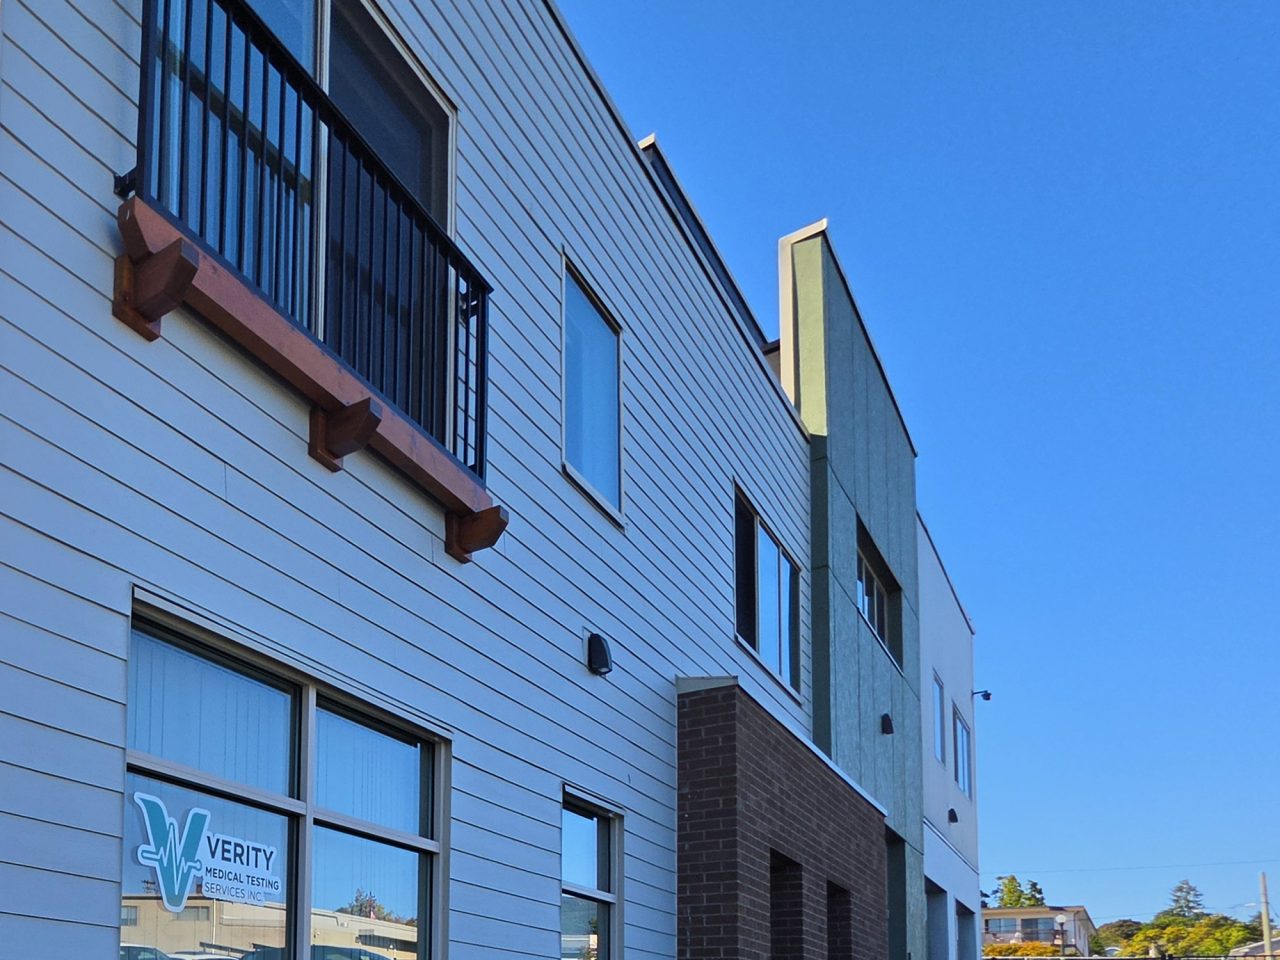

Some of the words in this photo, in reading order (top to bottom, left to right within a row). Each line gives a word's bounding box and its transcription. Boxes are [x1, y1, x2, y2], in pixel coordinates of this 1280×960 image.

[206, 836, 274, 871] VERITY
[204, 881, 246, 899] SERVICES
[205, 866, 244, 884] MEDICAL
[246, 875, 279, 891] TESTING
